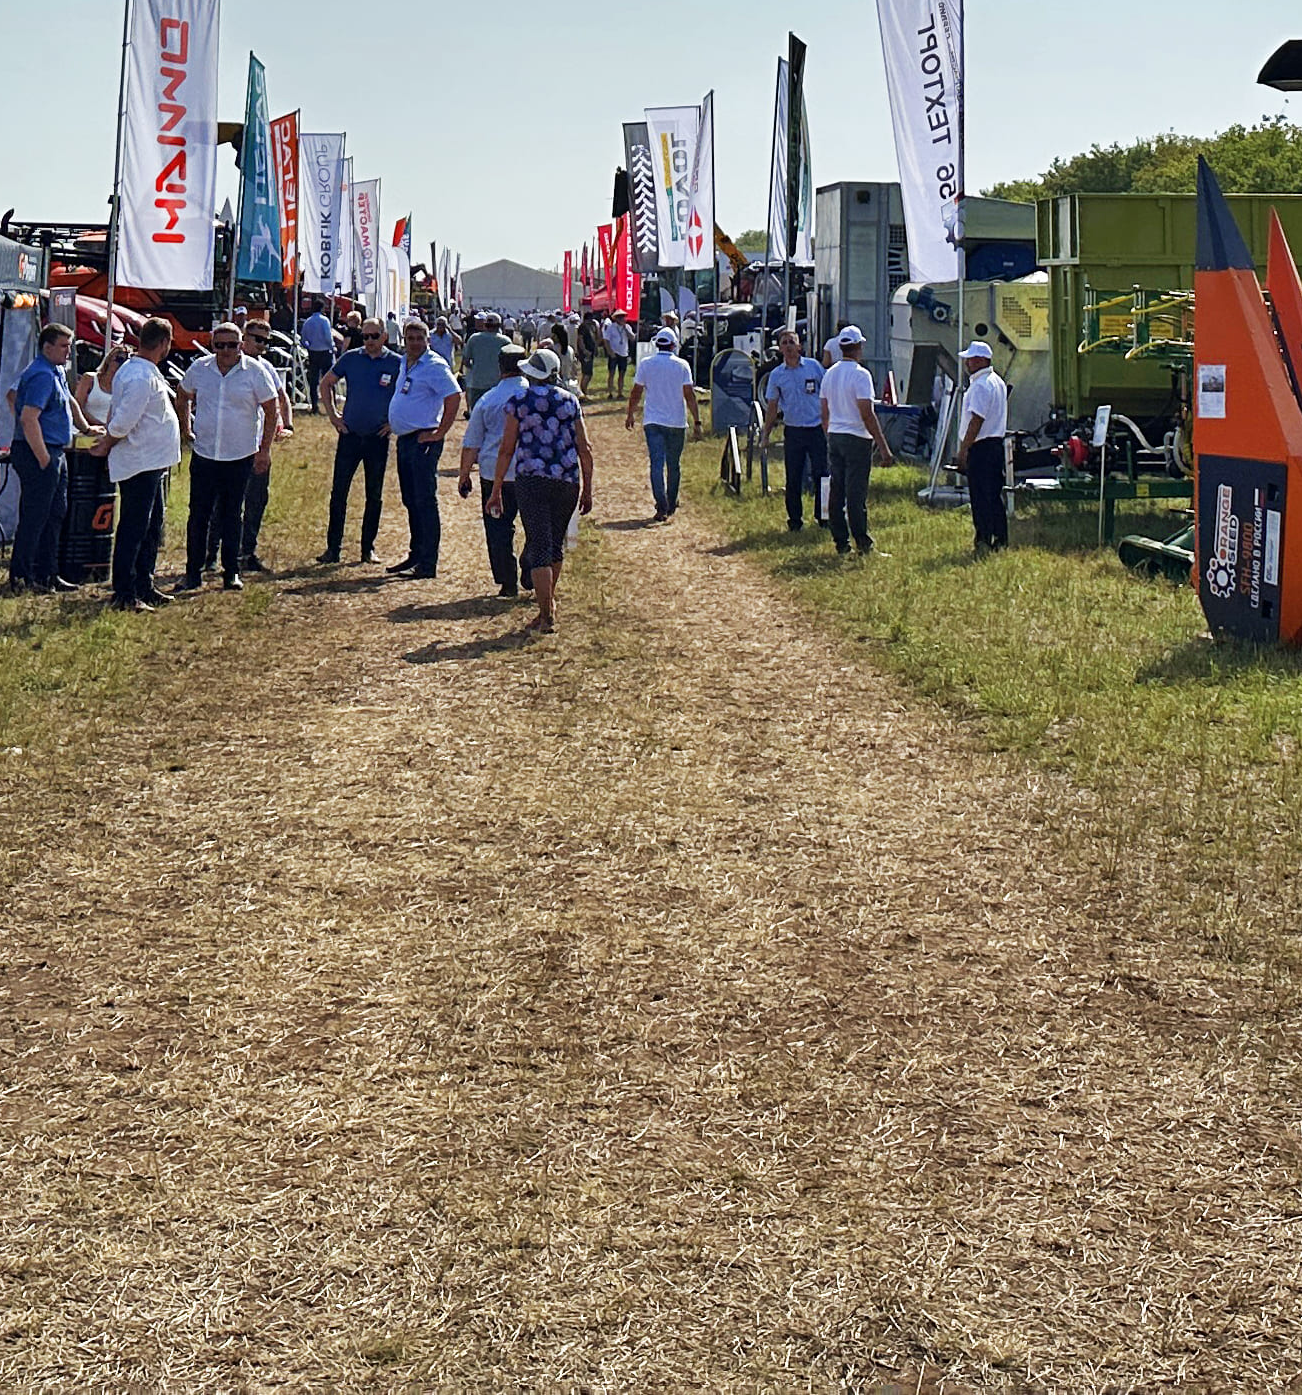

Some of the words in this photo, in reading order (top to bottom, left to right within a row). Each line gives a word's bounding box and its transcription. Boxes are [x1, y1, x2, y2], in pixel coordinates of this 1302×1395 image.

[1219, 486, 1232, 561] ORANGE
[1227, 517, 1237, 563] SEED
[1253, 507, 1263, 547] РОССИИ
[1250, 559, 1261, 609] СДЕЛАНО
